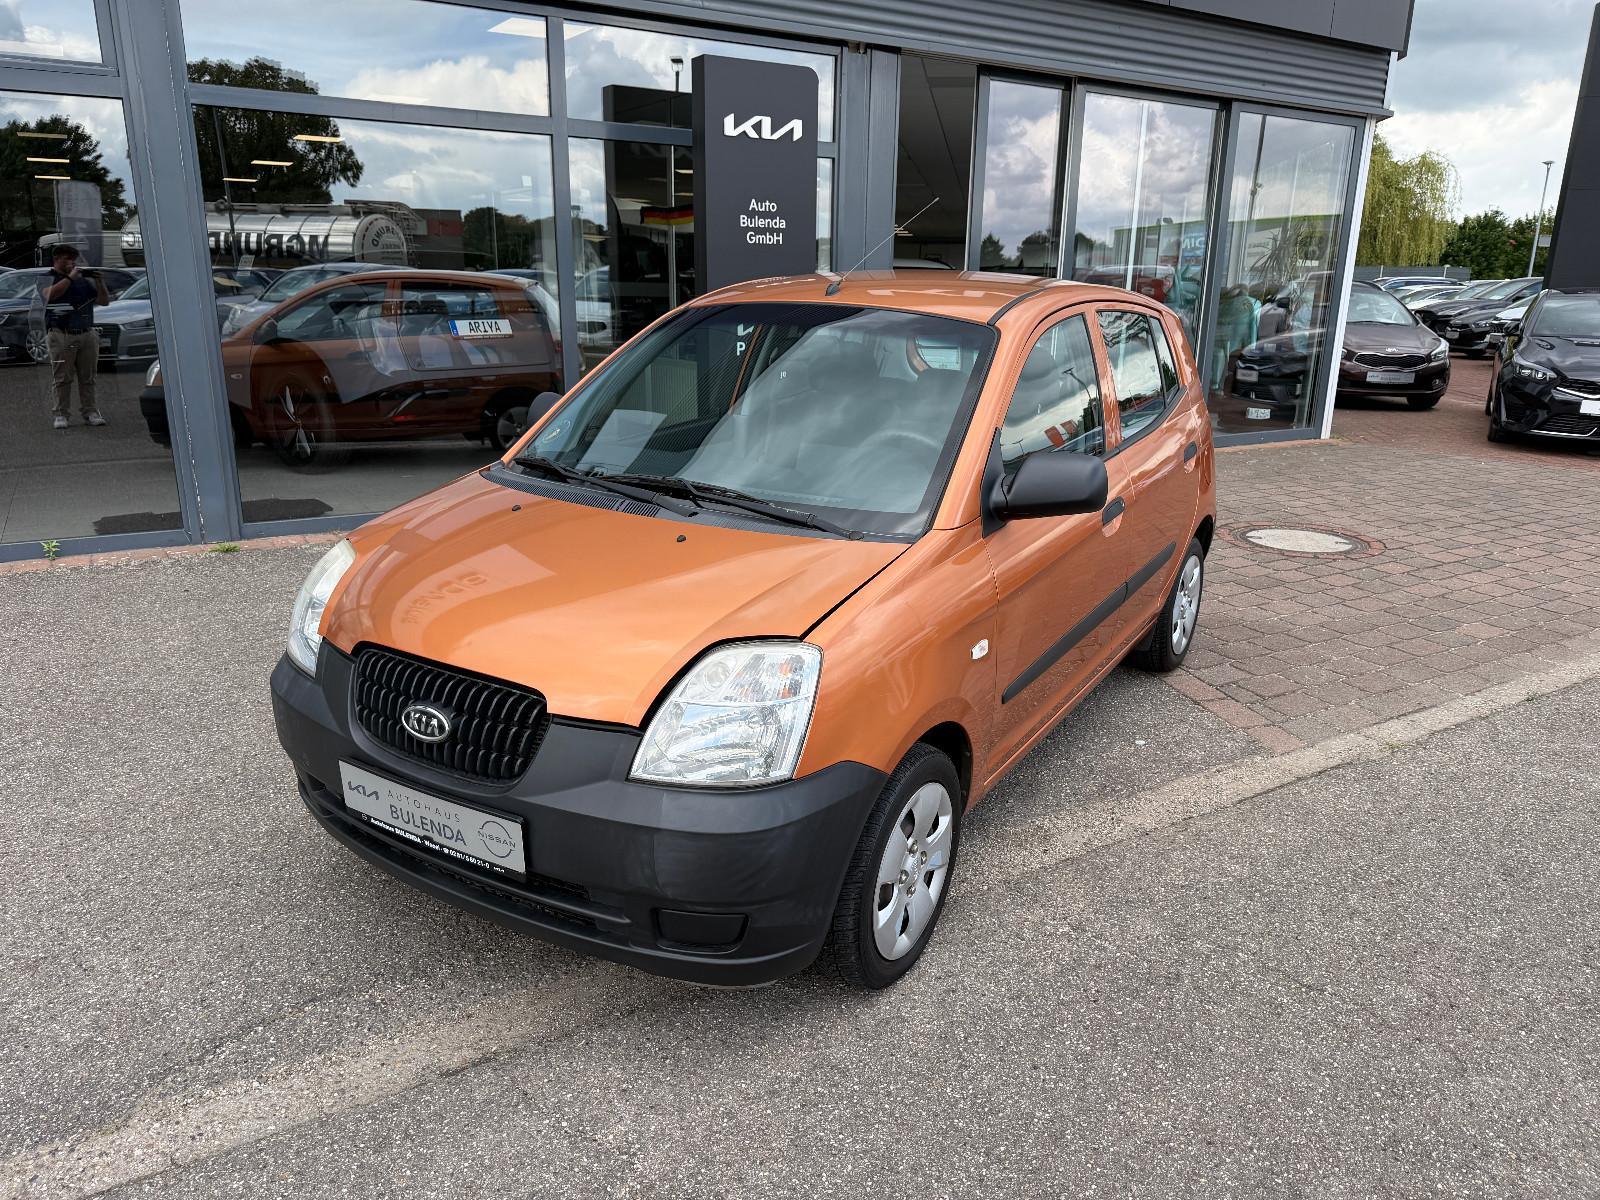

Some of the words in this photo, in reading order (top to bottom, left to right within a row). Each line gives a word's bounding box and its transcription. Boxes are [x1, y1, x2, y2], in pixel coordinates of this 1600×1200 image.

[724, 113, 803, 141] KIA
[749, 199, 777, 212] Auto
[740, 215, 786, 229] Bulenda
[746, 232, 783, 245] GmbH
[468, 321, 502, 333] ARIYA
[409, 711, 439, 736] KIA
[348, 781, 379, 801] KIA
[388, 790, 461, 823] AUTOHAUS
[389, 804, 467, 846] BULENDA
[395, 828, 421, 843] BULENDA
[477, 830, 516, 849] NISSAN
